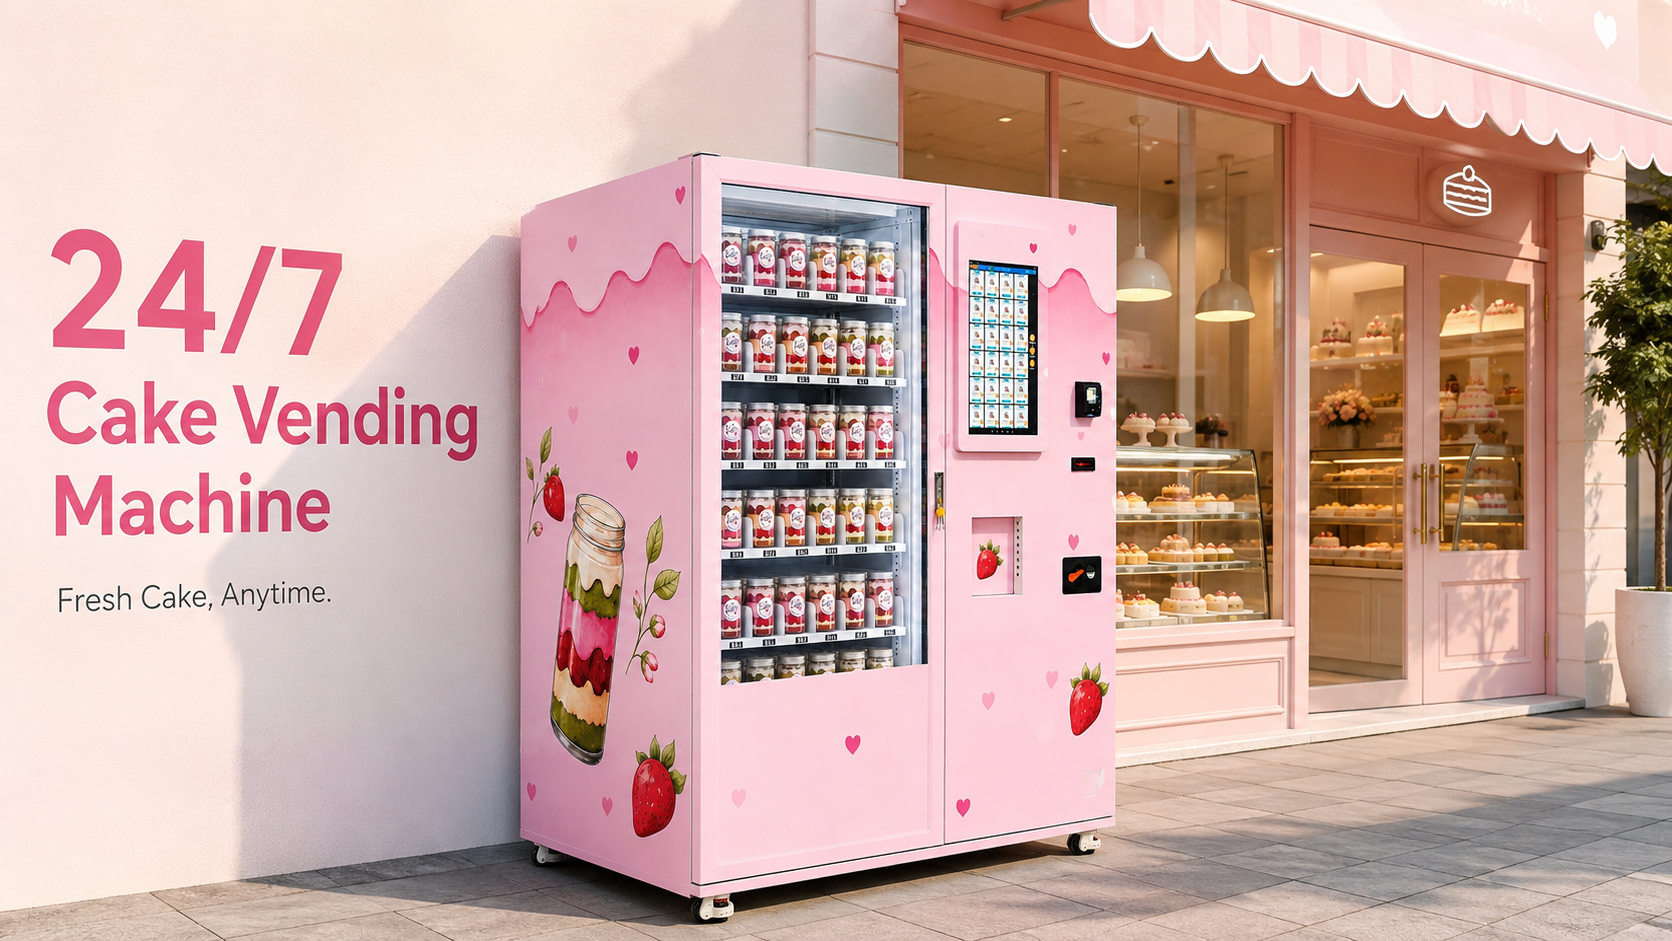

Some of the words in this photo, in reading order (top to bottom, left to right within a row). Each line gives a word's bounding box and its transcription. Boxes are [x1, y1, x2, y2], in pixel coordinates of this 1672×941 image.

[51, 228, 343, 355] 24/7
[47, 380, 217, 445] Cake
[233, 385, 478, 461] Vending
[55, 472, 331, 536] Machine
[58, 585, 132, 613] Fresh
[141, 584, 213, 611] Cake,
[221, 581, 332, 611] Anytime.
